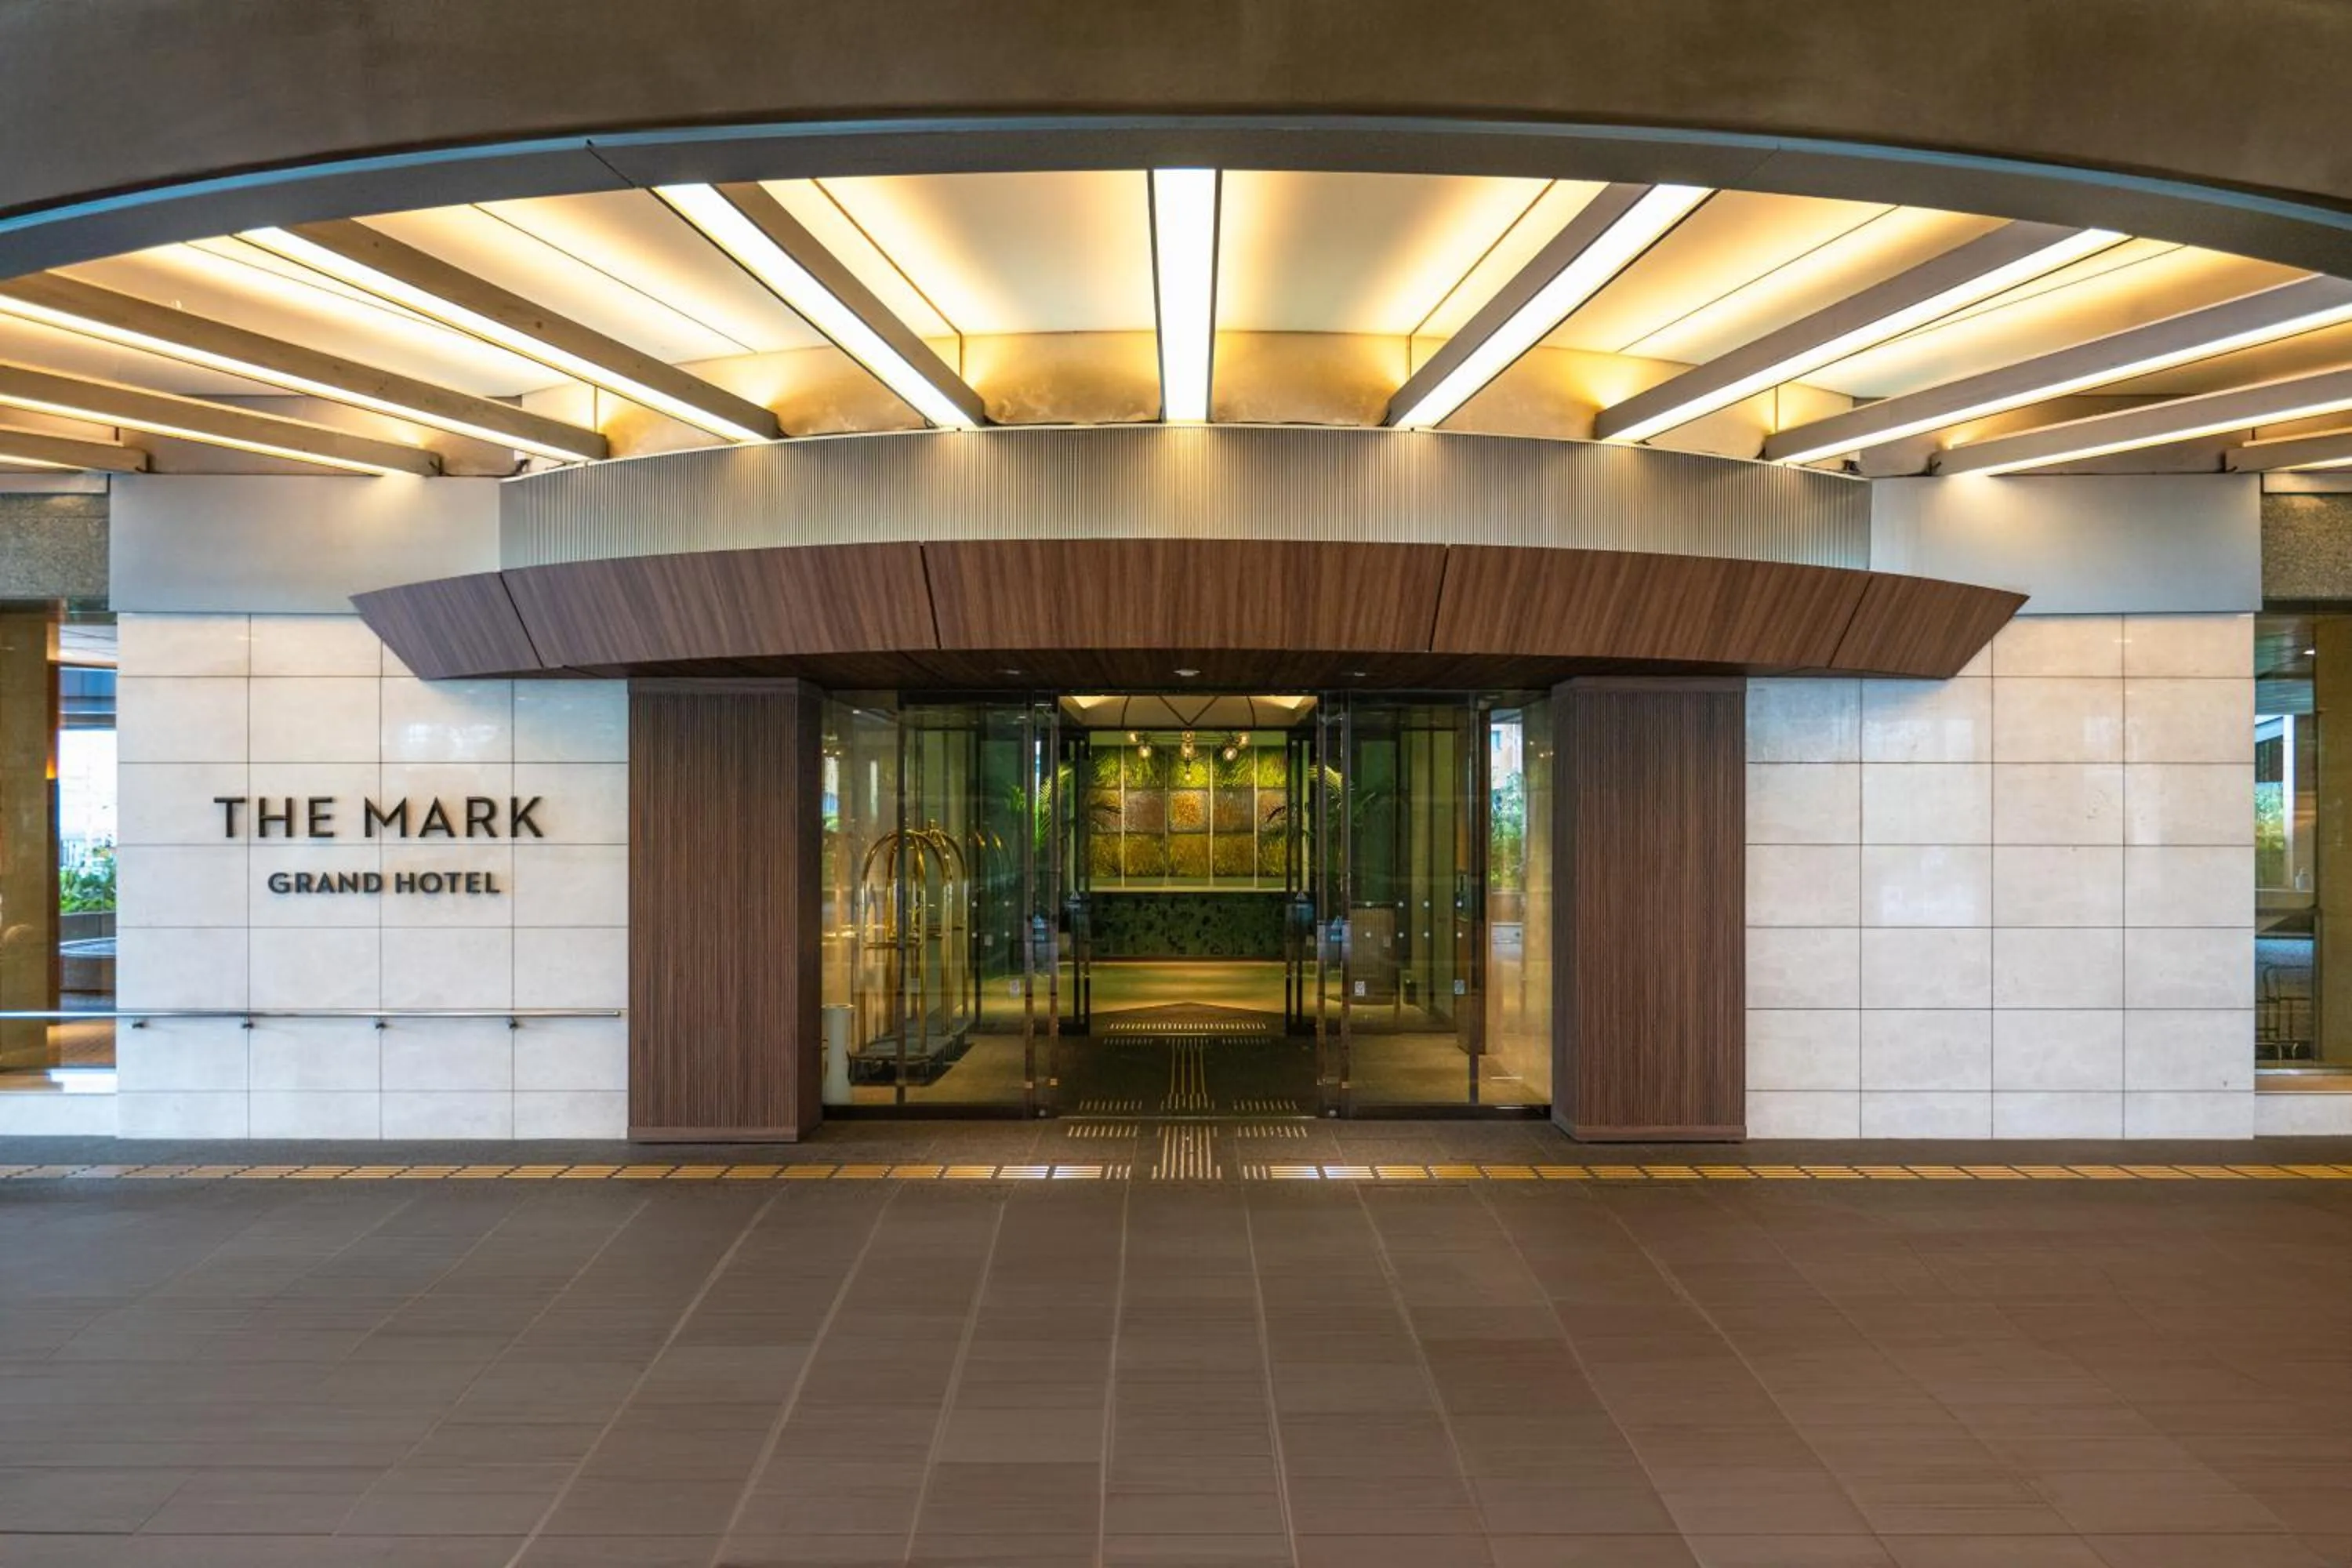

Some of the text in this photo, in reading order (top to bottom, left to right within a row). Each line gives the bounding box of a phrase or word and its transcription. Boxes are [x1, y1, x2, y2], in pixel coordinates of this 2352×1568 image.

[213, 796, 544, 838] THE MARK
[267, 872, 501, 894] GRAND HOTEL
